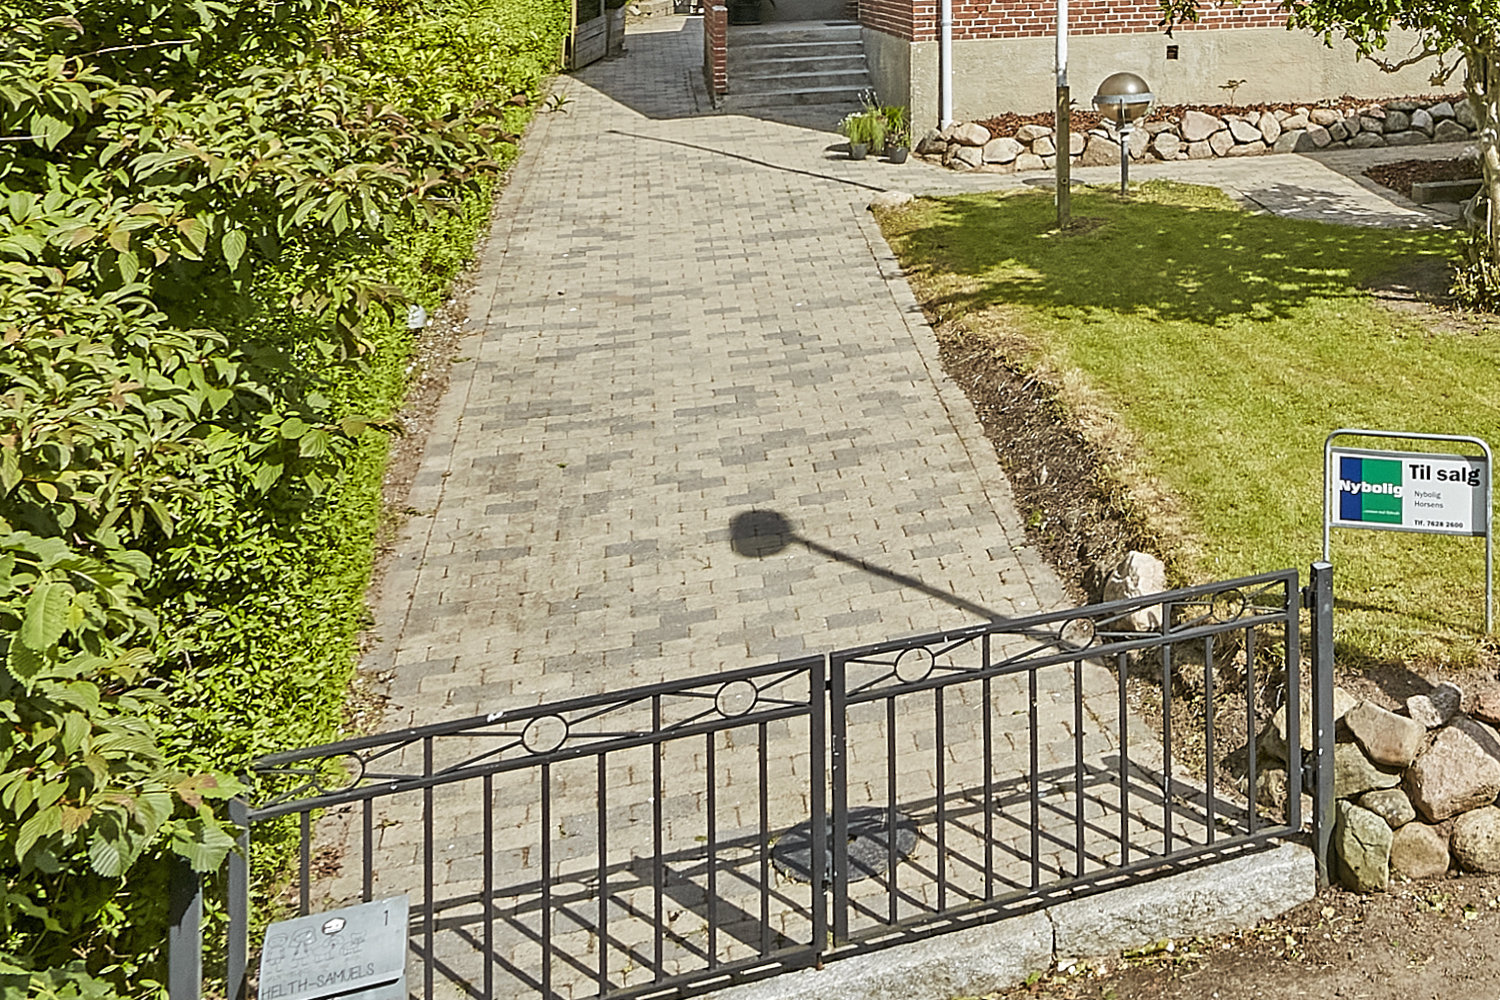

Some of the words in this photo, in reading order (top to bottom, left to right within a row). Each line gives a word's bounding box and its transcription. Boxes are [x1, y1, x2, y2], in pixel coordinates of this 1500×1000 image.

[1409, 464, 1431, 480] Til
[1437, 467, 1481, 486] salg
[1339, 479, 1403, 498] Nybolig
[1414, 490, 1442, 500] Nybolig
[1414, 500, 1444, 509] Horsens
[382, 909, 389, 927] 1
